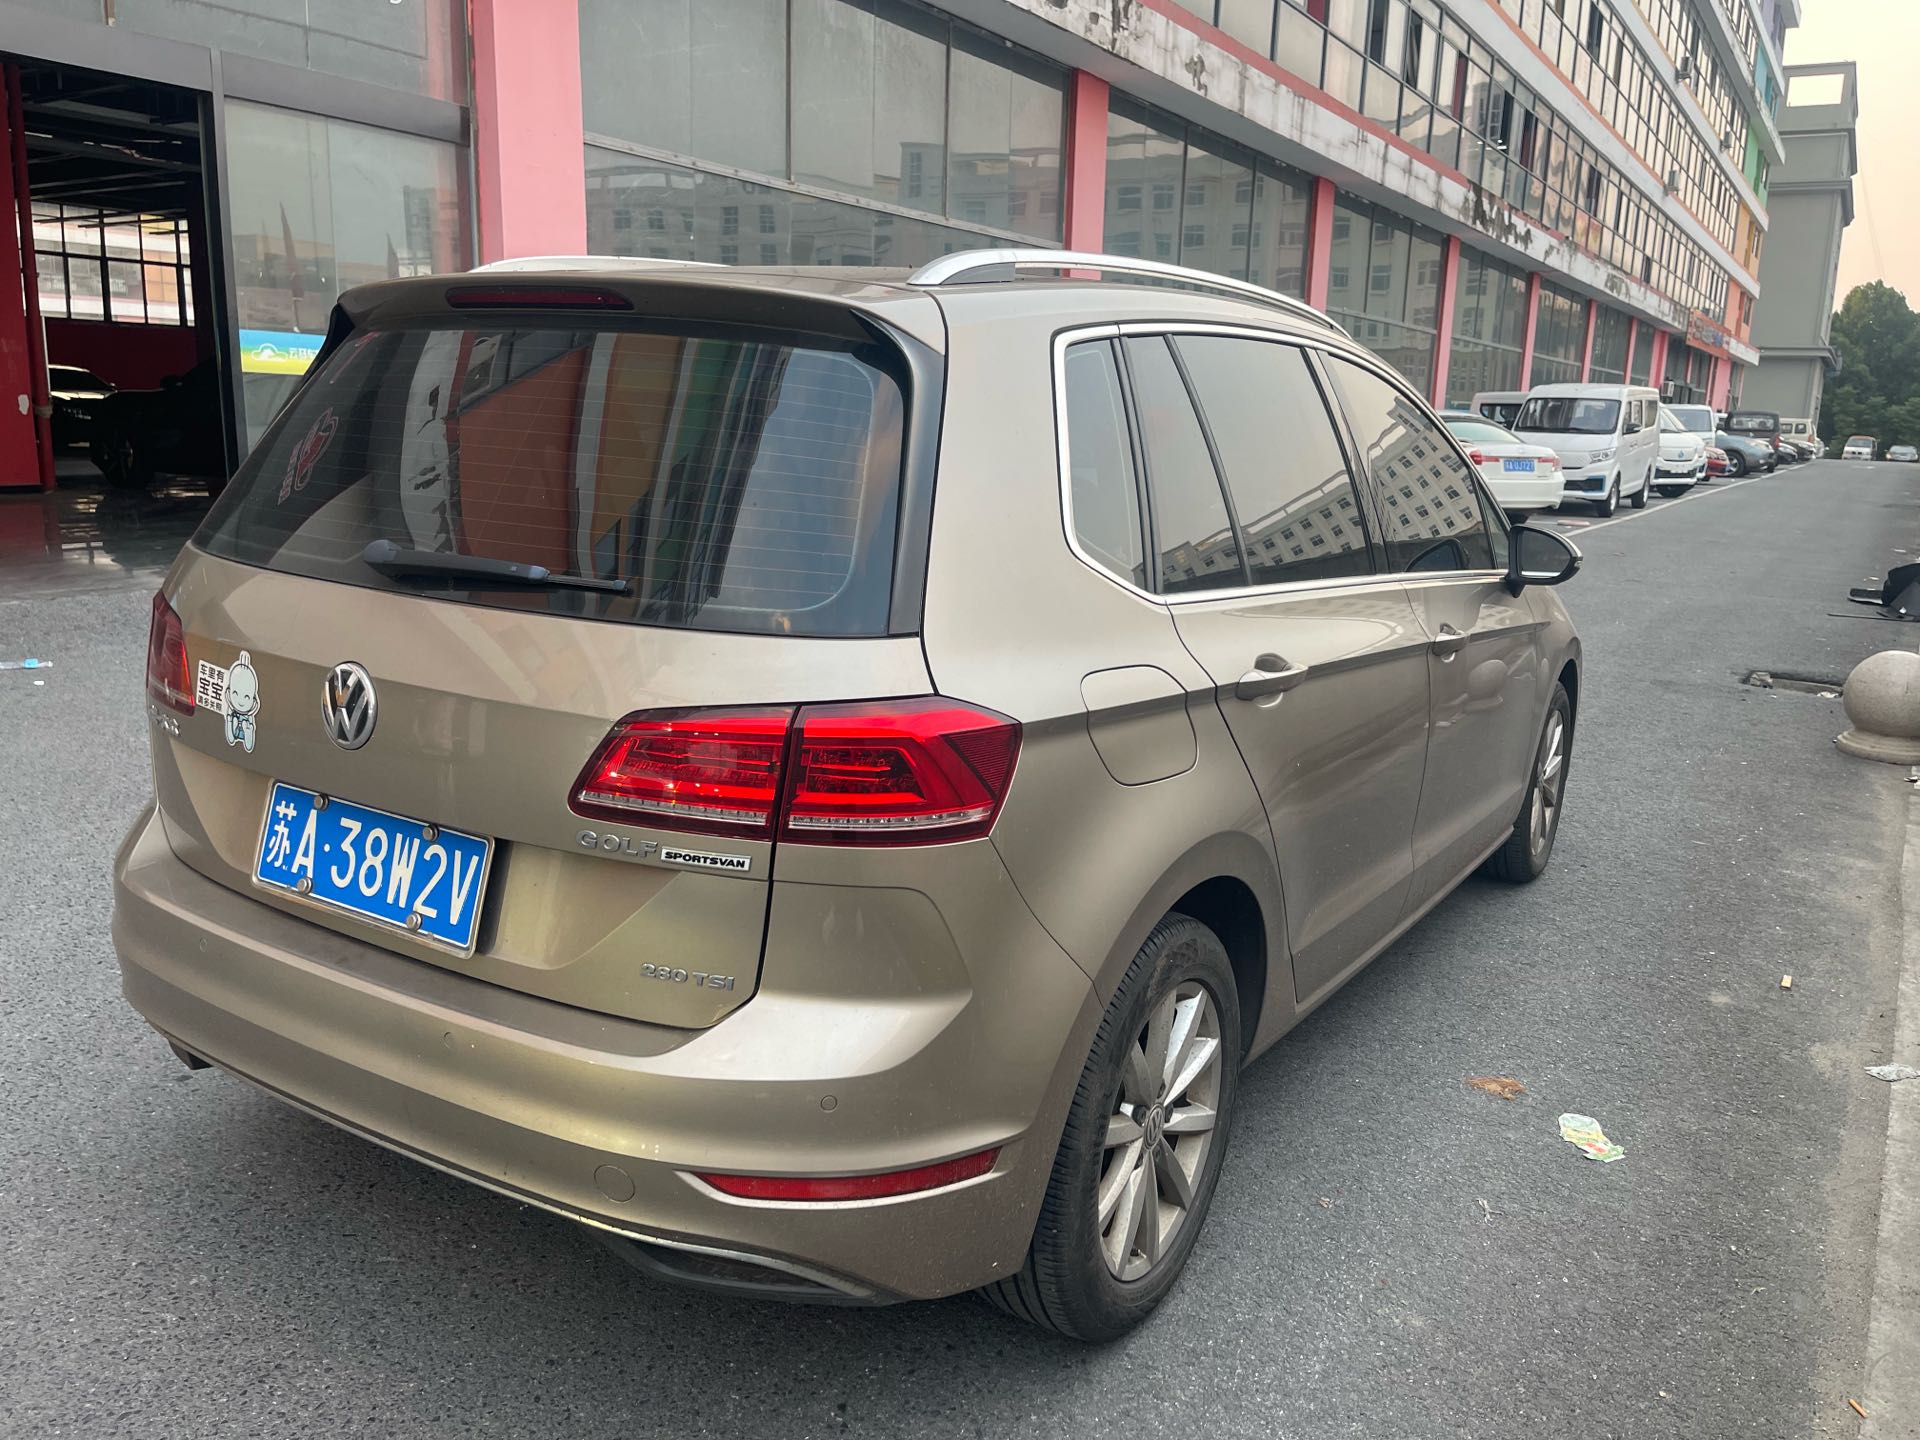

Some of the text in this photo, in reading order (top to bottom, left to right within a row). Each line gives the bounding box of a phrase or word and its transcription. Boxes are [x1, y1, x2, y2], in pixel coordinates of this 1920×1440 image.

[198, 676, 224, 702] 宝宝
[576, 829, 746, 869] GOLF SPORTSVAN
[640, 962, 736, 992] 280 TSI
